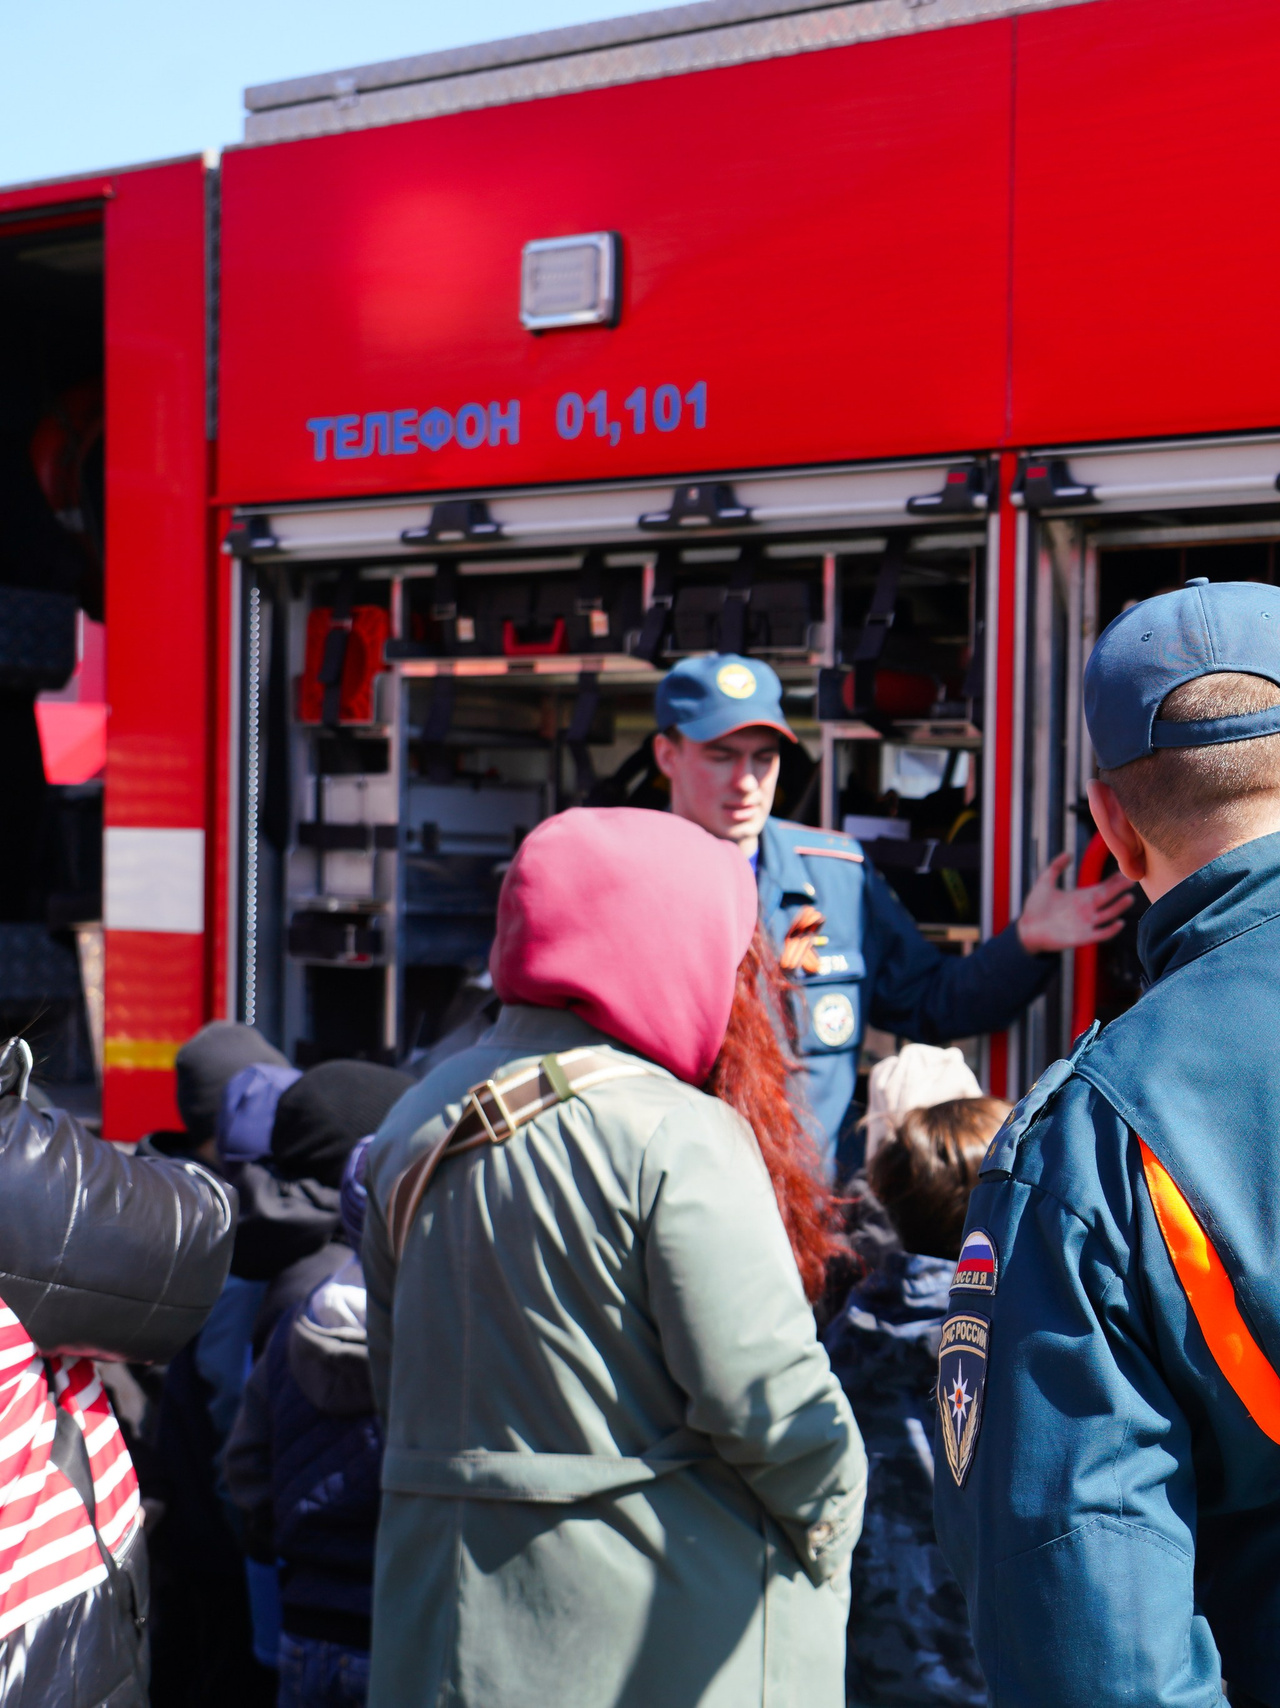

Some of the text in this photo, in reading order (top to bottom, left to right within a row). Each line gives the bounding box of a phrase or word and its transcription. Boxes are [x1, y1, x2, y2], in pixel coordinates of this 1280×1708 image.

[307, 381, 707, 461] ТЕЛЕФОН 01,101
[953, 1271, 988, 1285] РОССИЯ
[955, 1321, 987, 1350] РОССИИ
